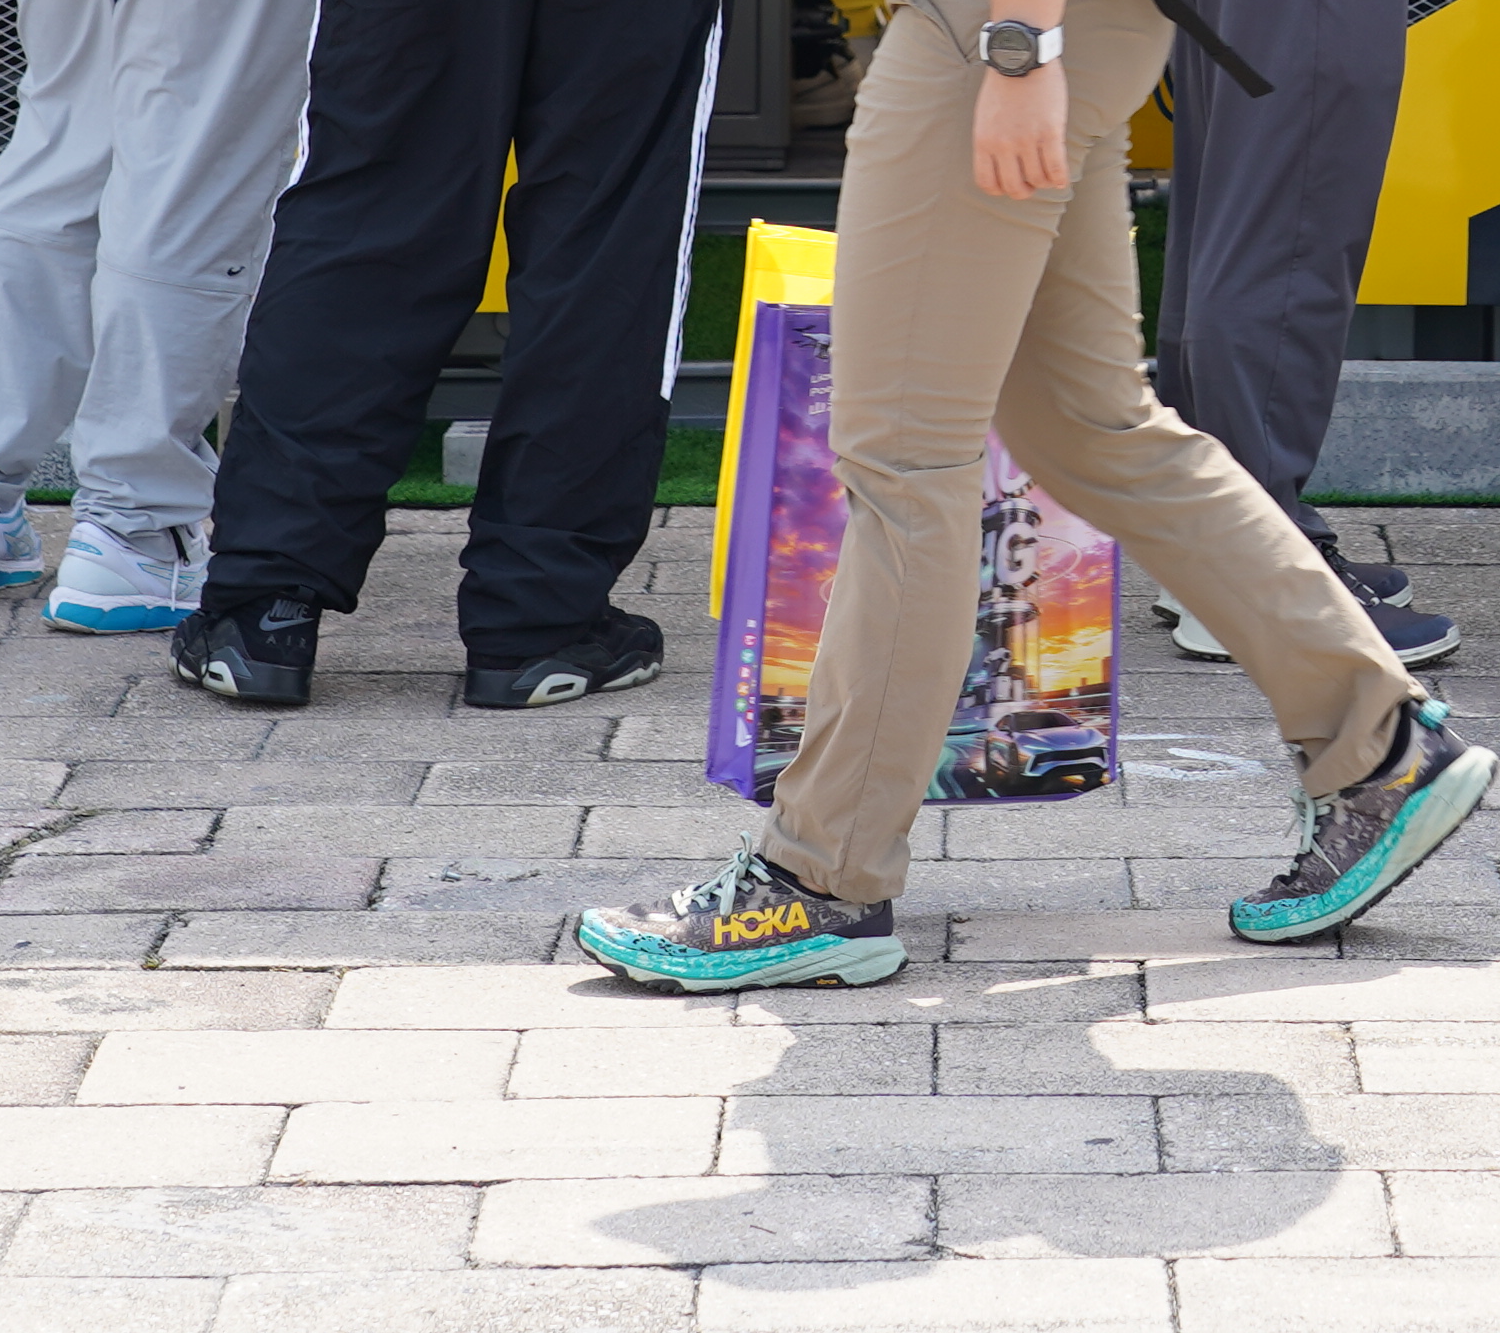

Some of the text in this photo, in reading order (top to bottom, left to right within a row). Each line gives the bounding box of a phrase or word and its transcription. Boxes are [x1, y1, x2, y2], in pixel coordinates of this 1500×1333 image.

[269, 598, 310, 621] NIKE
[265, 634, 307, 649] AIR
[712, 901, 811, 946] HOKA
